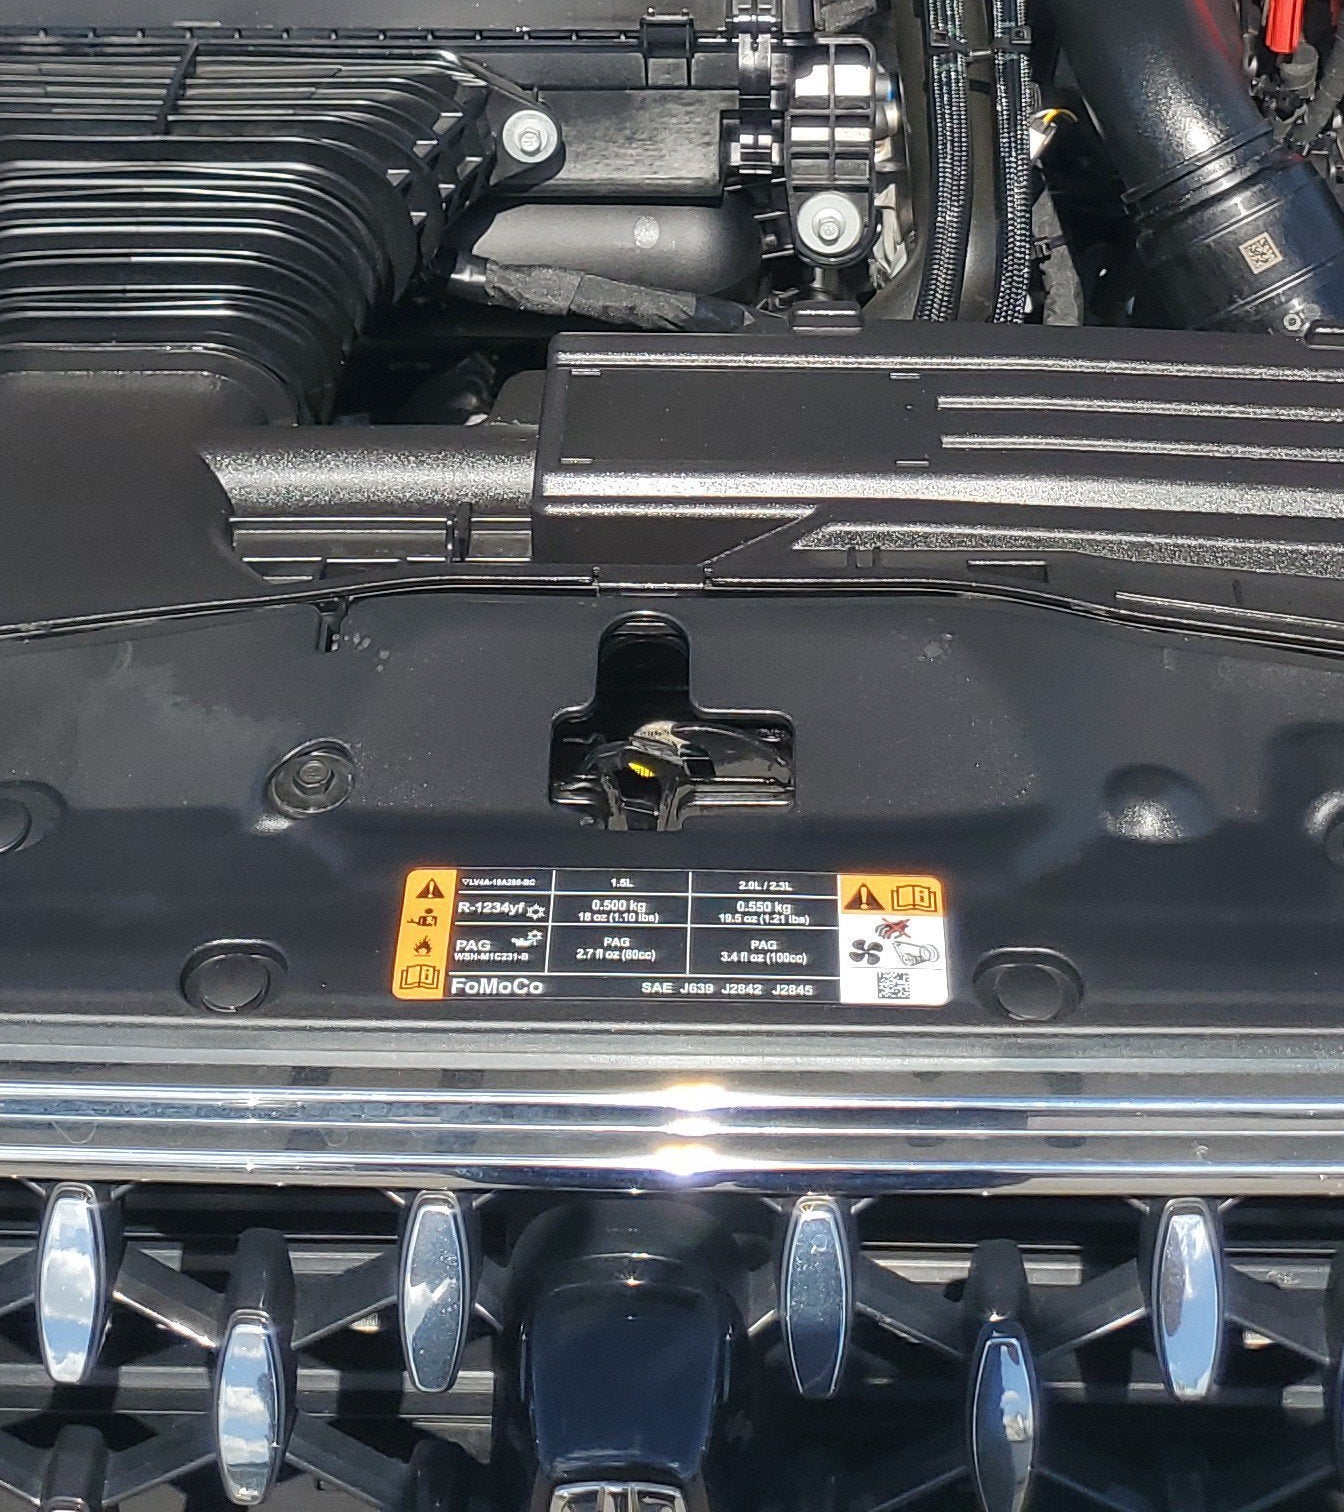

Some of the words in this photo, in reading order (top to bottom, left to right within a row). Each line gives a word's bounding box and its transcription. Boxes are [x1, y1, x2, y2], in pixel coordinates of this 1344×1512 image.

[610, 878, 634, 888] 1.5L
[738, 881, 763, 891] 2.0L
[458, 901, 525, 916] R-1234yf
[591, 899, 626, 911] 0.500
[629, 899, 647, 913] kg
[736, 900, 772, 913] 0.550
[774, 901, 793, 914] kg
[593, 913, 608, 922] oz
[609, 912, 636, 923] (1.10
[638, 912, 659, 923] lbs)
[743, 915, 758, 924] oz
[760, 914, 785, 925] (1.21
[788, 914, 810, 926] lbs)
[455, 939, 492, 952] PAG
[604, 936, 630, 947] PAG
[750, 939, 778, 950] PAG
[576, 948, 593, 959] 2.7
[595, 949, 604, 960] fl
[605, 950, 620, 960] oz
[720, 951, 738, 963] 3.4
[740, 952, 748, 963] fl
[750, 954, 765, 963] oz
[766, 952, 808, 965] (100cc)
[451, 977, 544, 995] FoMoCo
[641, 981, 674, 994] SAE
[679, 982, 714, 994] J639
[721, 983, 763, 995] J2842
[771, 984, 814, 996] J2845
